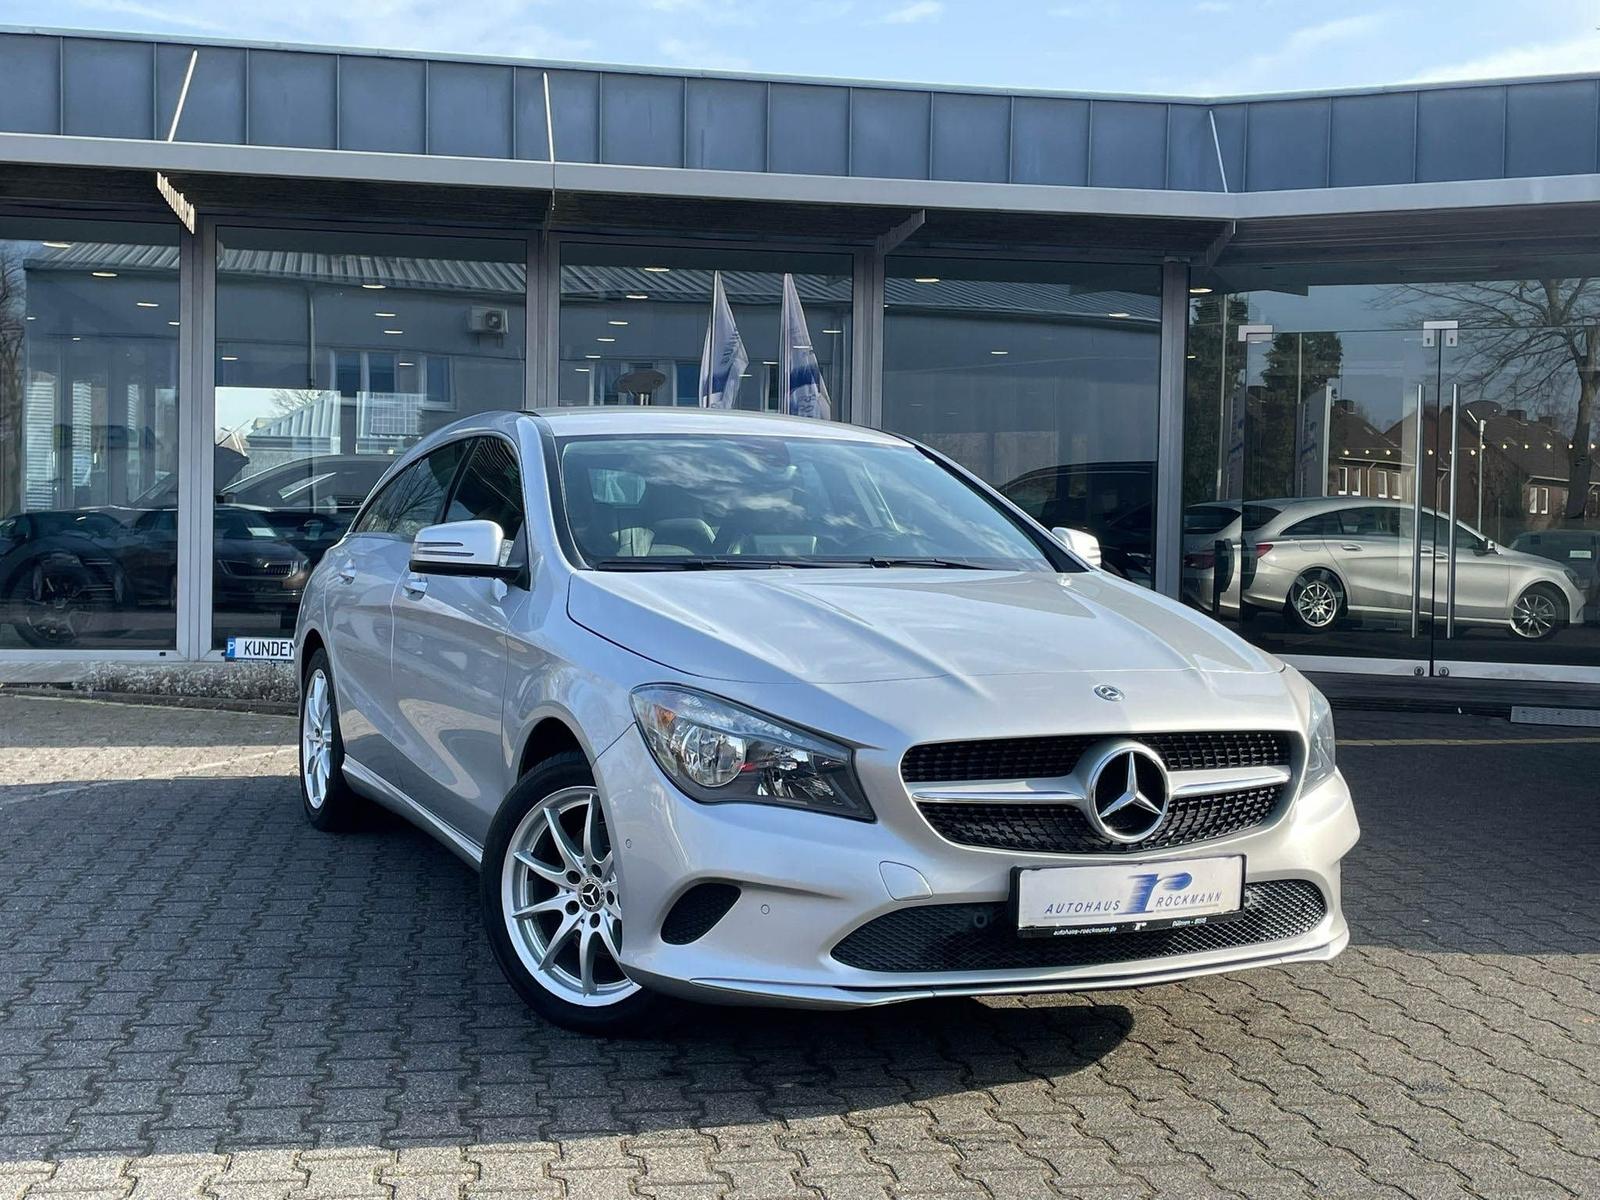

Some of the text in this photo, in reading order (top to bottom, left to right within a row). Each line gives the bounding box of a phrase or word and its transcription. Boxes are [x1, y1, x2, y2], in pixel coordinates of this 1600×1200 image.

[227, 641, 235, 654] P
[1044, 891, 1222, 915] AUTOHAUS RÖCKMANN
